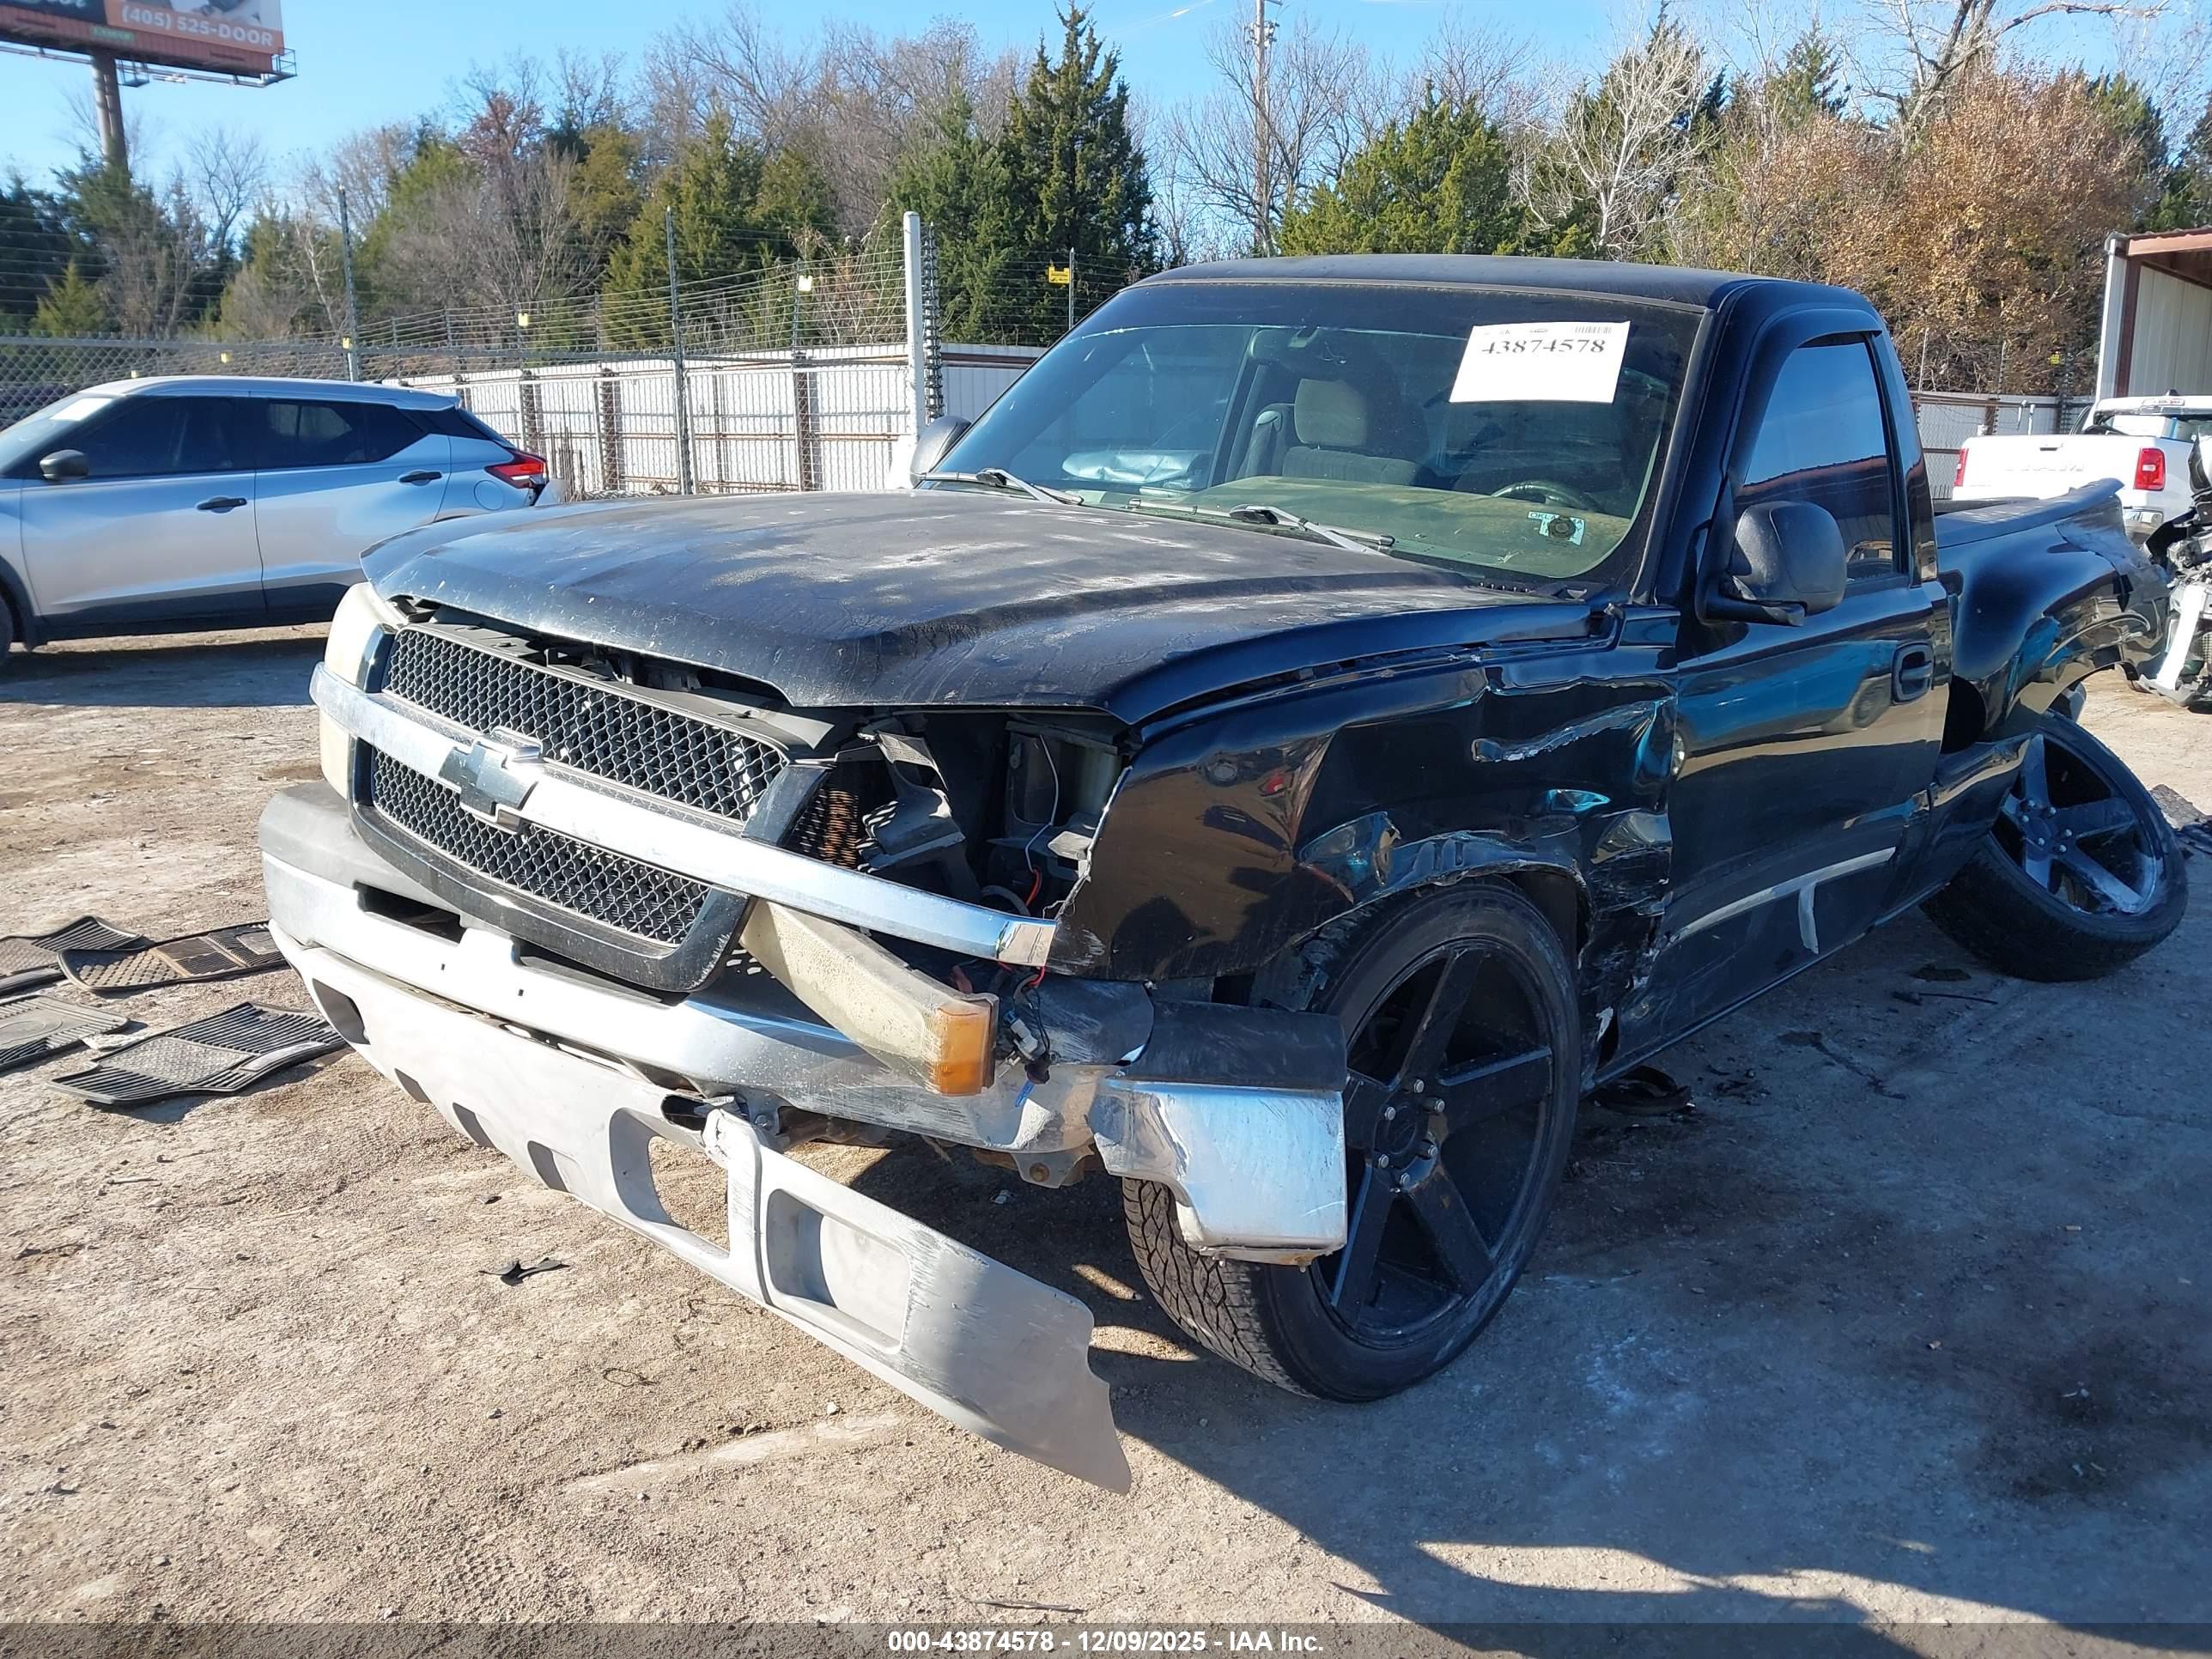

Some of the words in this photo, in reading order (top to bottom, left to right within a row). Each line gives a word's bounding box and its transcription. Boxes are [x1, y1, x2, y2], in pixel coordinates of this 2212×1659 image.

[121, 5, 171, 30] (405)
[177, 15, 273, 46] 525-DOOR
[1481, 338, 1606, 355] 43874578
